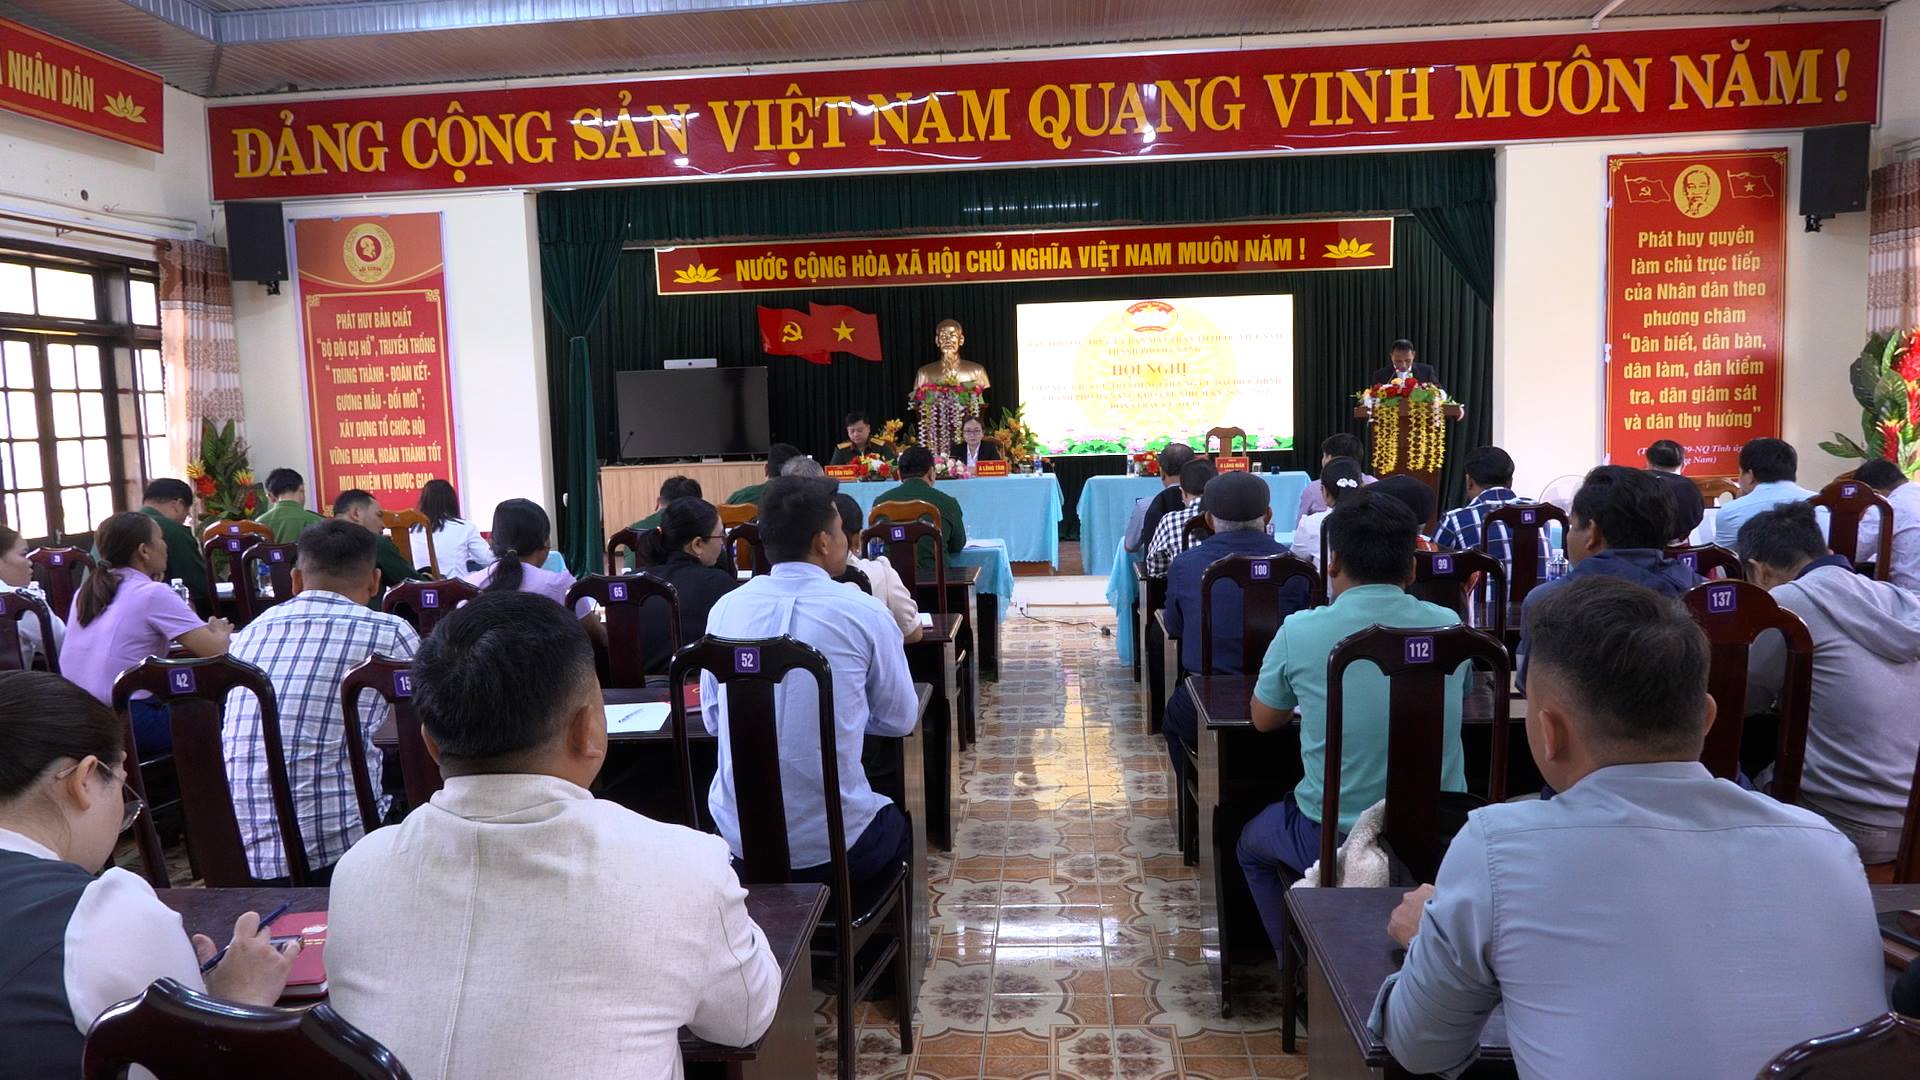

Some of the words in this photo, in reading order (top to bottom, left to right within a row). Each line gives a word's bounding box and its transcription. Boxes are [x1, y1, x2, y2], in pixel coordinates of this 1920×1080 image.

[7, 49, 57, 101] NHÂN
[61, 65, 95, 113] DÂN
[231, 110, 389, 179] ĐẢNG
[401, 101, 557, 183] CỘNG
[573, 89, 690, 161] SẢN
[709, 83, 851, 166] VIỆT
[869, 88, 1011, 147] NAM
[1028, 75, 1246, 150] QUANG
[1263, 66, 1436, 129] VINH
[1455, 43, 1654, 120] MUÔN
[1638, 230, 1673, 248] Phát
[1677, 230, 1704, 247] huy
[1709, 225, 1754, 246] quyền
[735, 251, 788, 282] NƯỚC
[794, 251, 846, 283] CỘNG
[851, 249, 889, 278] HÒA
[895, 249, 923, 276] XÃ
[927, 247, 960, 279] HỘI
[966, 241, 1006, 274] CHỦ
[1011, 243, 1072, 272] NGHĨA
[1077, 240, 1120, 272] VIỆT
[1125, 241, 1172, 267] NAM
[1178, 235, 1243, 266] MUÔN
[1631, 258, 1660, 275] làm
[1664, 254, 1692, 273] chủ
[1697, 257, 1727, 275] trực
[1732, 250, 1761, 272] tiếp
[1624, 282, 1652, 301] của
[1657, 282, 1696, 300] Nhân
[1701, 281, 1728, 298] dân
[1733, 280, 1766, 297] theo
[335, 310, 356, 330] PHÁT
[357, 312, 372, 329] HUY
[374, 306, 391, 328] BẢN
[393, 304, 412, 327] CHẤT
[1643, 310, 1699, 328] phương
[1704, 307, 1746, 324] châm
[333, 337, 347, 361] ĐỘI
[348, 340, 360, 360] CỤ
[379, 333, 409, 355] TRUYỀN
[410, 331, 435, 354] THỐNG
[1664, 331, 1697, 352] biết,
[1702, 333, 1729, 350] dân
[1734, 332, 1766, 350] bàn,
[358, 364, 384, 383] THÀNH
[390, 363, 412, 382] ĐOÀN
[1623, 363, 1651, 379] dân
[1656, 361, 1689, 379] làm,
[1694, 360, 1721, 376] dân
[1726, 354, 1764, 375] kiểm
[335, 393, 362, 411] GƯƠNG
[363, 388, 381, 410] MẪU
[388, 387, 401, 409] ĐỔI
[1630, 388, 1655, 406] tra,
[1659, 387, 1686, 404] dân
[1692, 385, 1729, 404] giám
[1734, 384, 1757, 401] sát
[339, 419, 354, 438] XÂY
[356, 421, 377, 440] DỰNG
[378, 414, 388, 437] TỔ
[389, 416, 411, 436] CHỨC
[412, 416, 425, 438] HỘI
[1624, 414, 1641, 431] và
[1646, 412, 1673, 429] dân
[1678, 412, 1701, 432] thụ
[329, 446, 350, 464] VỮNG
[351, 448, 378, 467] MẠNH,
[378, 444, 399, 464] HOÀN
[400, 443, 426, 463] THÀNH
[427, 440, 442, 461] TỐT
[355, 471, 381, 494] NHIỆM
[381, 474, 393, 493] VỤ
[394, 472, 415, 493] ĐƯỢC
[1254, 564, 1267, 576] 100
[426, 593, 434, 604] 77
[614, 586, 623, 598] 65
[1712, 591, 1731, 607] 137
[741, 653, 754, 668] 52
[1409, 642, 1430, 658] 112
[176, 673, 189, 688] 42
